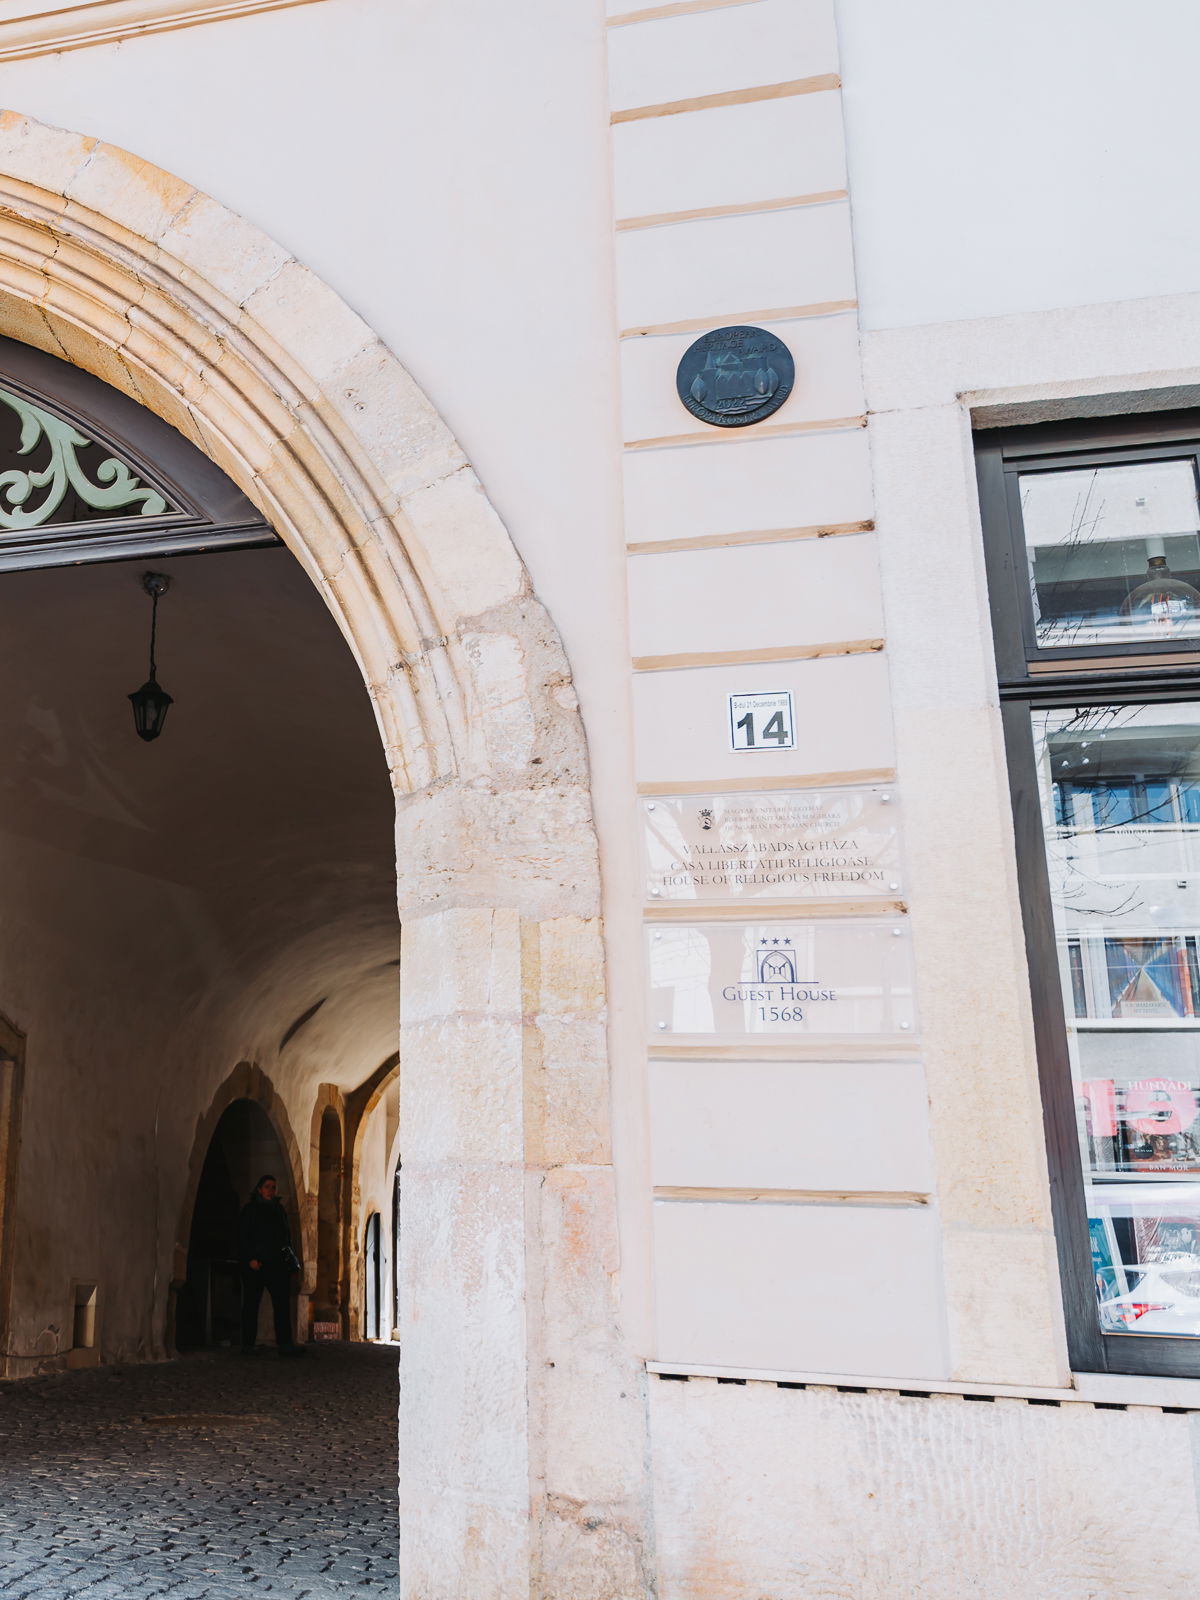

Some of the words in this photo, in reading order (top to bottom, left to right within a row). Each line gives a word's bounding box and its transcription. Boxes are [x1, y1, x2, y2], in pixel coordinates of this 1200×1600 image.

[737, 711, 789, 746] 14
[819, 838, 860, 851] HÁZA
[670, 860, 705, 872] CASA
[787, 857, 874, 869] RELIGIOASE
[663, 876, 710, 887] HOUSE
[712, 875, 730, 885] OF
[735, 873, 810, 884] RELIGIOUS
[814, 871, 885, 882] FREEDOM
[722, 986, 774, 1001] GUEST
[780, 986, 838, 1001] HOUSE
[759, 1006, 803, 1022] 1568
[1128, 1080, 1191, 1091] HUNYADI
